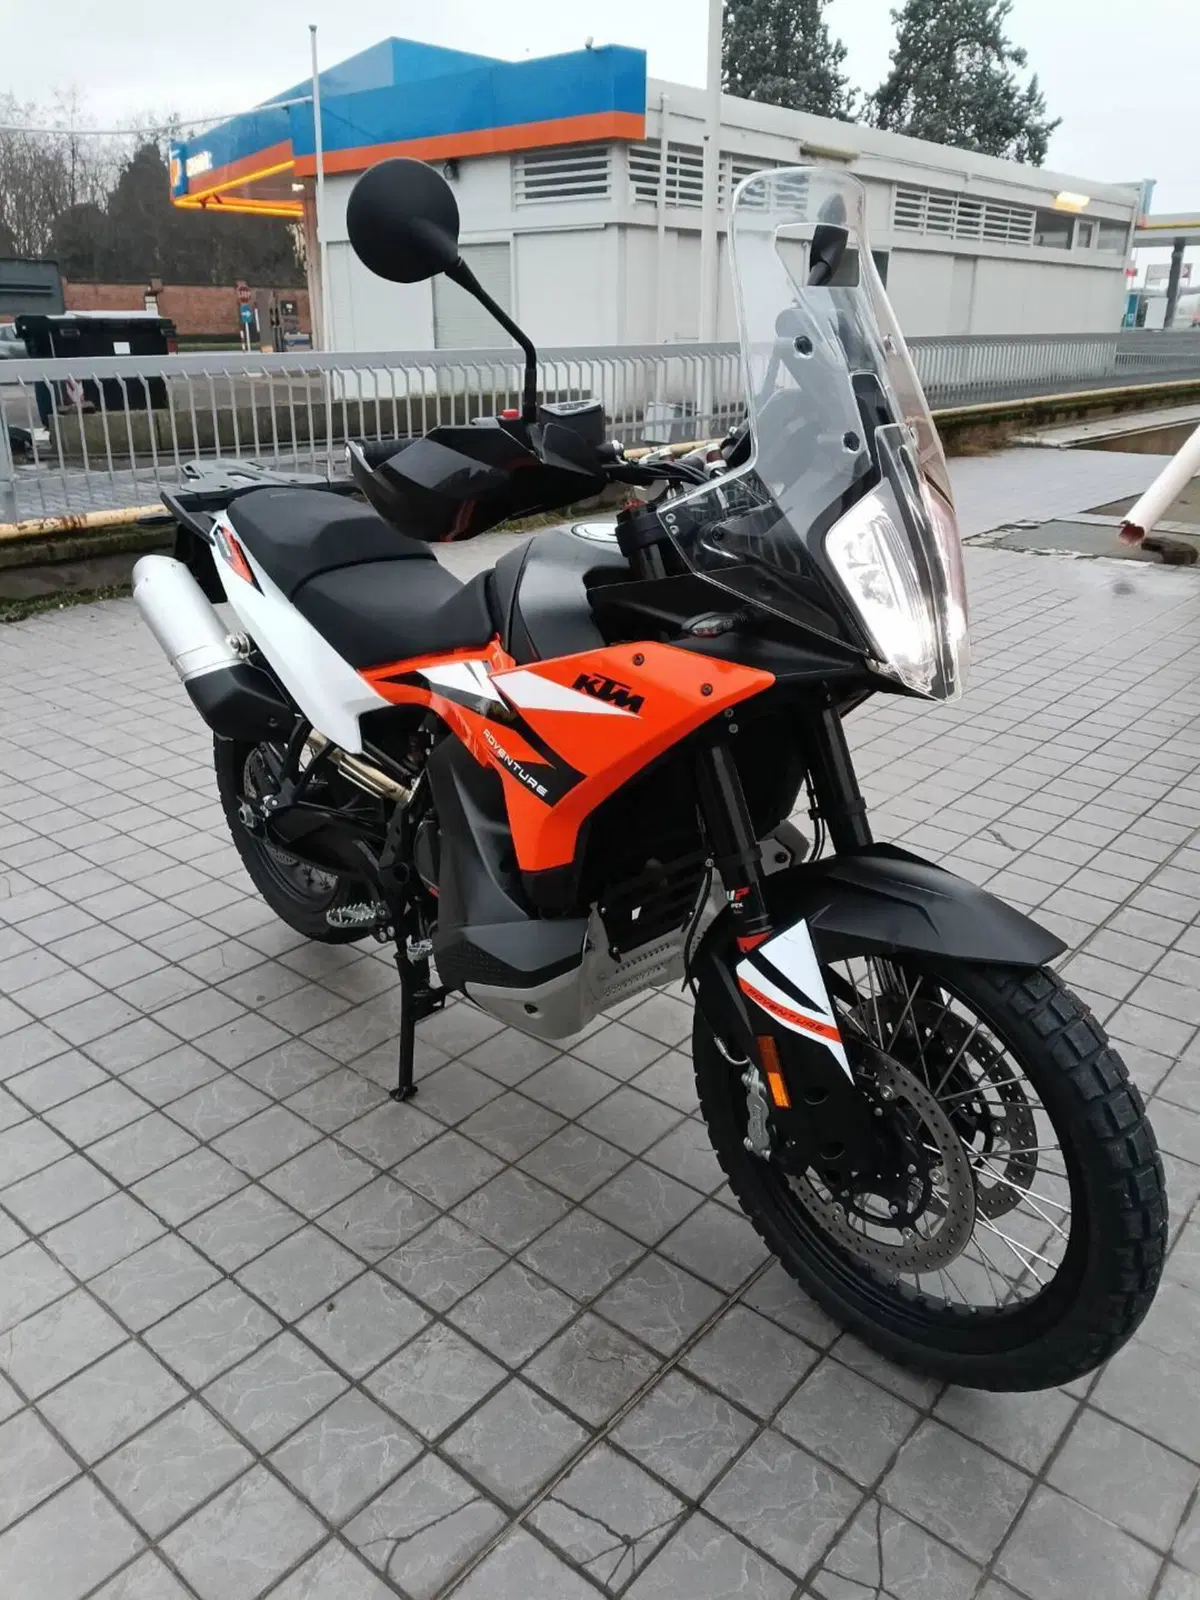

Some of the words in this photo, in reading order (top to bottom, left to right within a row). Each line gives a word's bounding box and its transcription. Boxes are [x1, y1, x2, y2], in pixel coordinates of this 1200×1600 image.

[571, 672, 645, 714] KTM
[482, 728, 549, 797] ADVENTURE
[747, 988, 826, 1032] ADVENTURE
